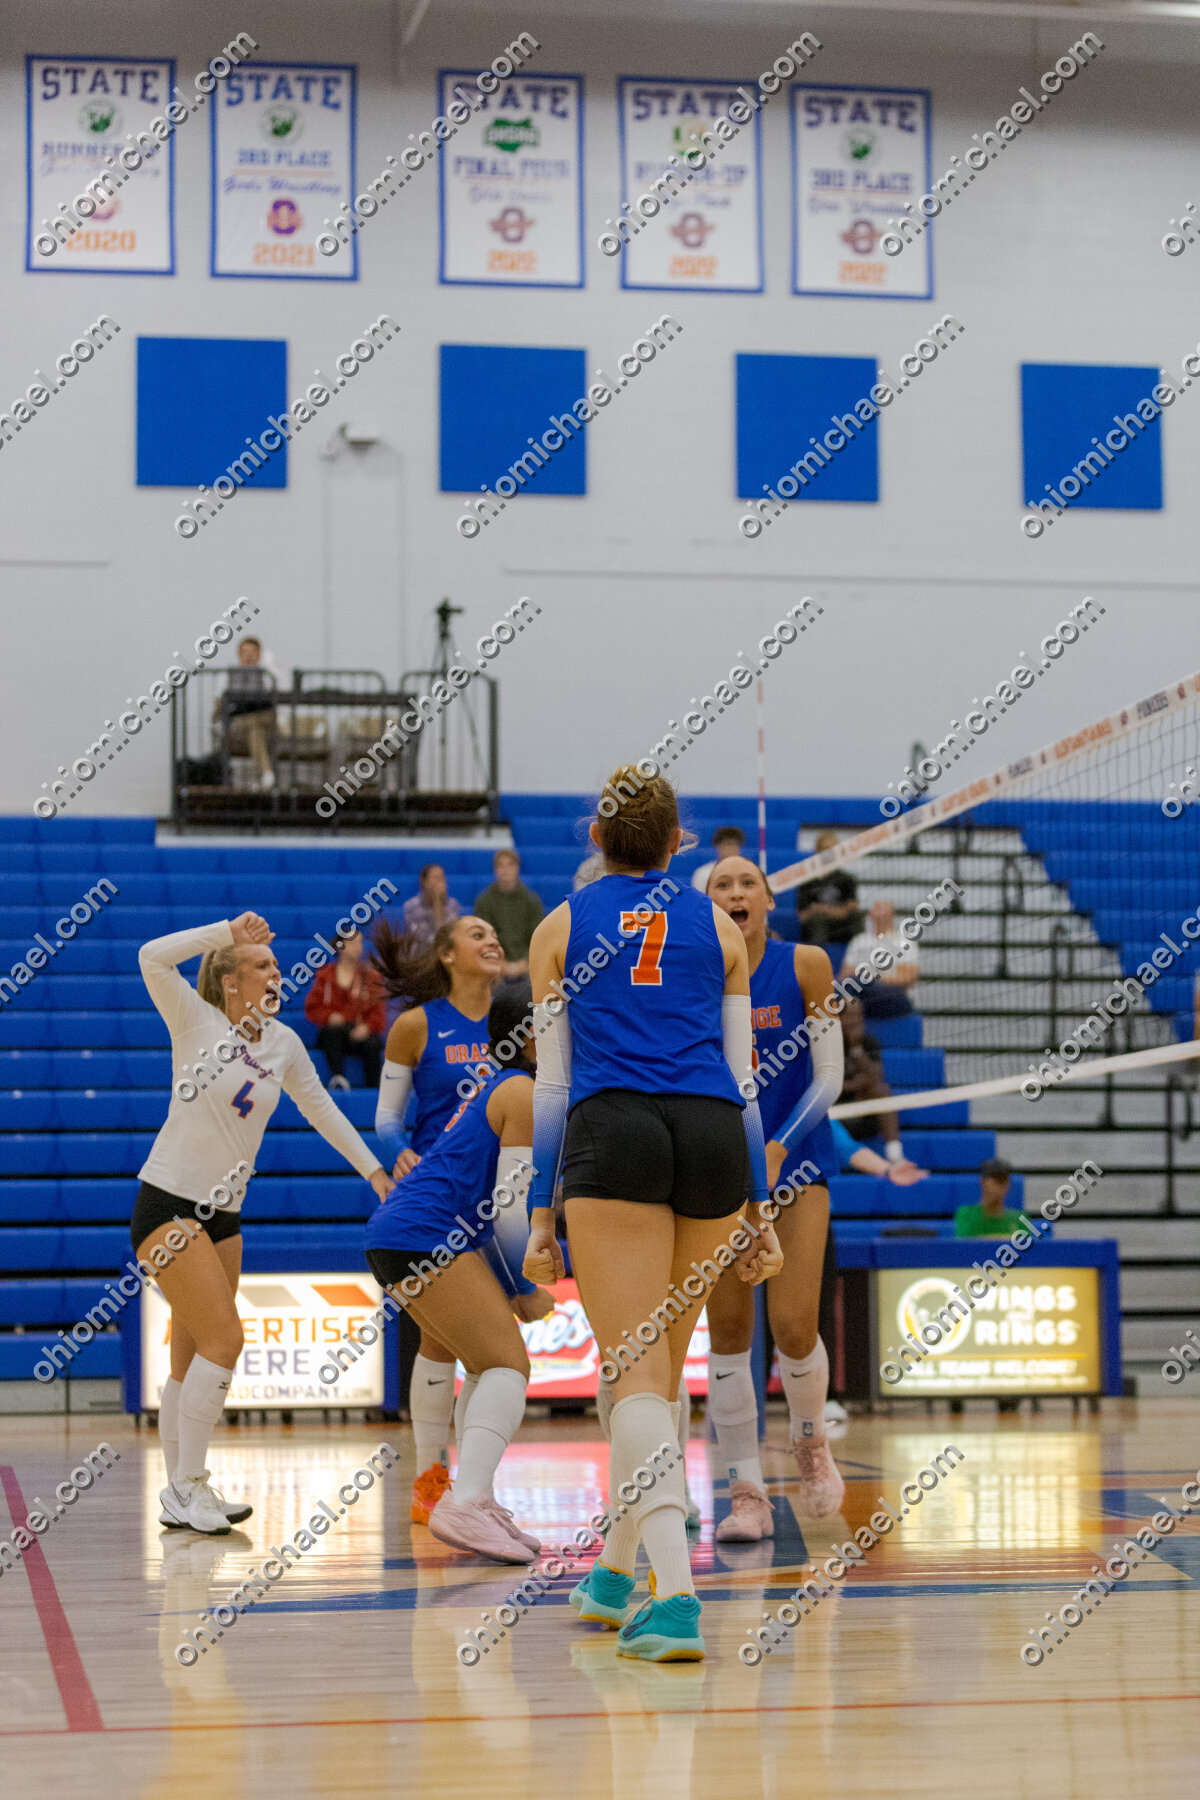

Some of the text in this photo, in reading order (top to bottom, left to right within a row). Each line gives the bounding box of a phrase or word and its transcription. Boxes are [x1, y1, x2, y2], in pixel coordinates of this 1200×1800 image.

[42, 66, 160, 104] STATE
[226, 73, 341, 111] STATE
[805, 95, 918, 134] STATE
[619, 910, 669, 987] 7
[230, 1080, 256, 1119] 4
[974, 1285, 1077, 1311] WINGS
[164, 1316, 370, 1346] ERTISE
[974, 1319, 1078, 1346] RINGS
[234, 1349, 311, 1376] ERE
